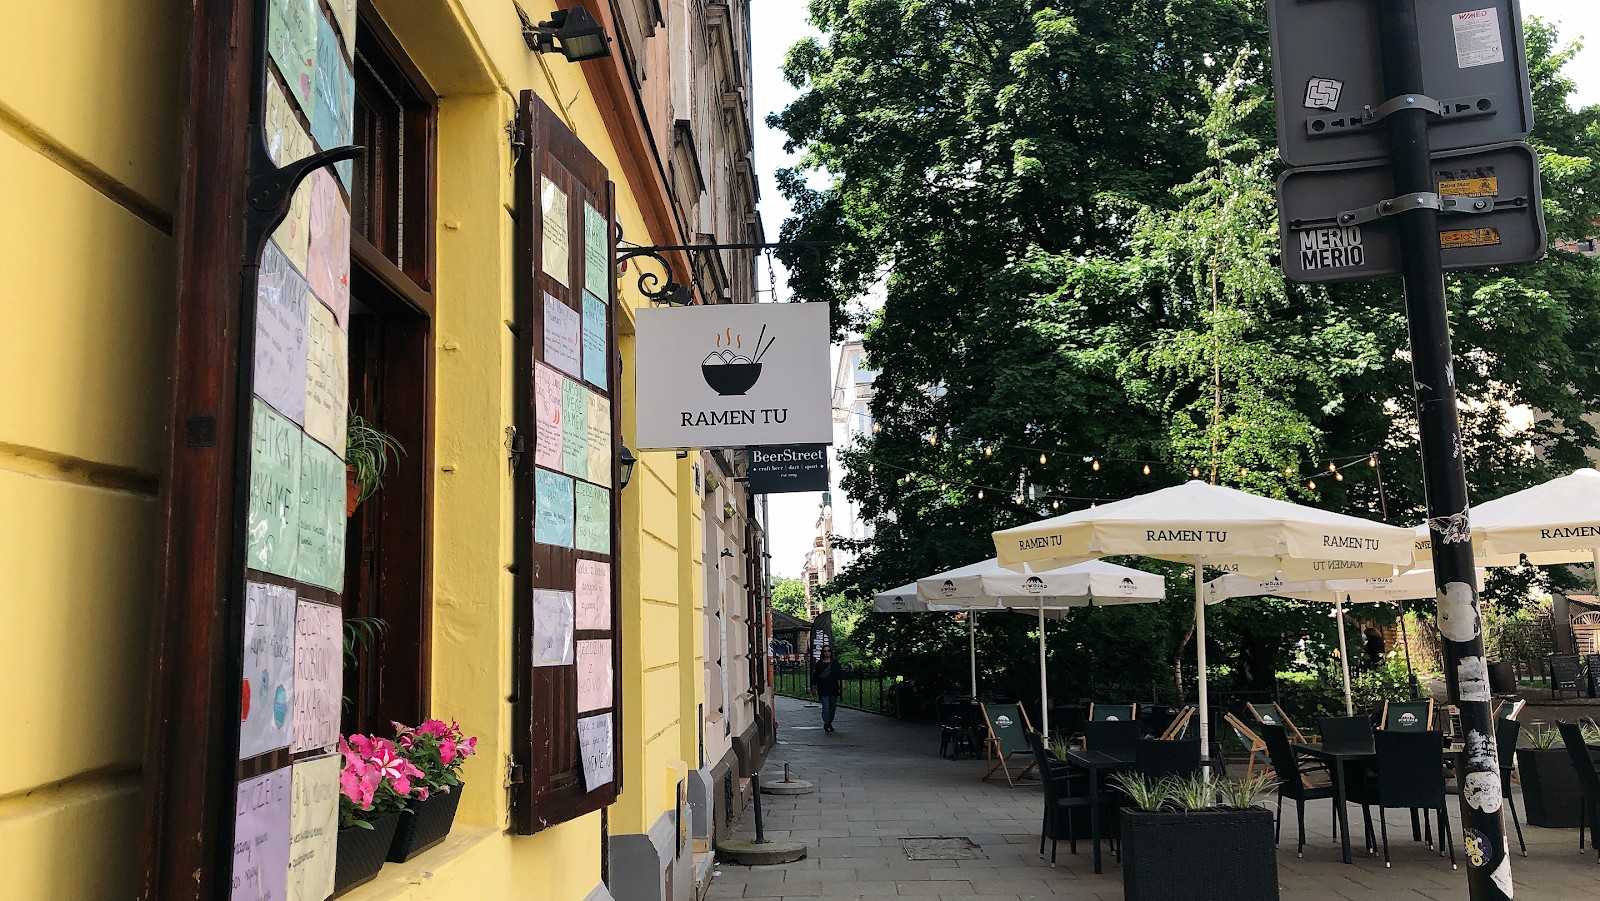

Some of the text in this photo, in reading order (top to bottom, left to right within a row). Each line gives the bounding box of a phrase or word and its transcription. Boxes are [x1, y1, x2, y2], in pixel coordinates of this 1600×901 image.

[1300, 226, 1362, 250] MERIO
[1301, 245, 1364, 269] MERIO
[680, 408, 788, 427] RAMEN TU
[752, 448, 824, 463] BeerStreet
[1146, 530, 1228, 543] RAMEN TU
[1541, 526, 1600, 539] RAMEN
[1018, 535, 1063, 551] RAMEN TU
[1322, 535, 1380, 551] RAMEN TU
[588, 663, 593, 673] Z
